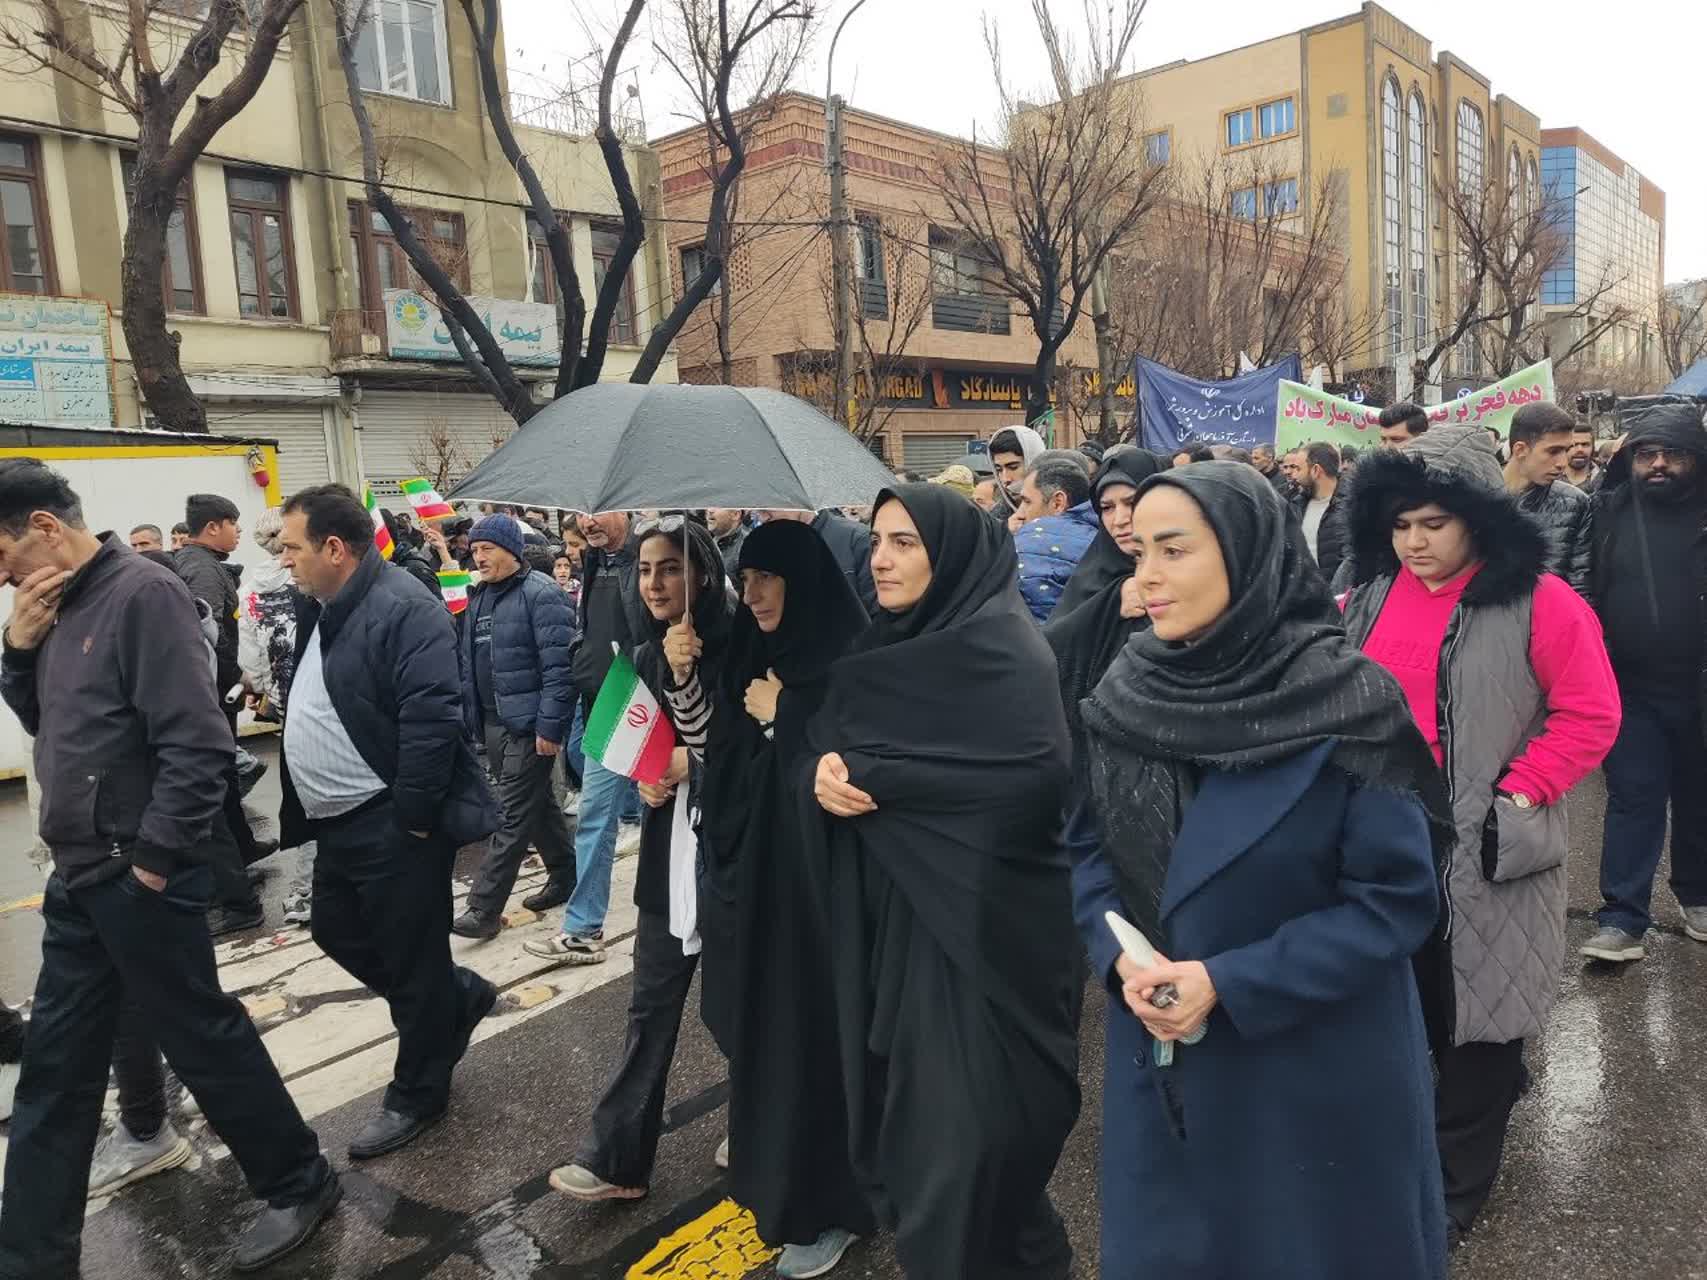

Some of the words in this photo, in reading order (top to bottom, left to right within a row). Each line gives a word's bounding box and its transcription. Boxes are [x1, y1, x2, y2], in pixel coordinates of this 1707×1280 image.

[1, 337, 49, 355] ایران
[499, 320, 543, 350] بیمه
[56, 341, 90, 356] بیمه
[960, 376, 1021, 409] پاسارگاد
[1509, 384, 1543, 406] دهه
[1197, 401, 1231, 420] آموزش
[1231, 398, 1247, 421] کل
[1245, 404, 1265, 417] اداره
[1284, 395, 1307, 424] باد
[1472, 386, 1507, 422] فجر
